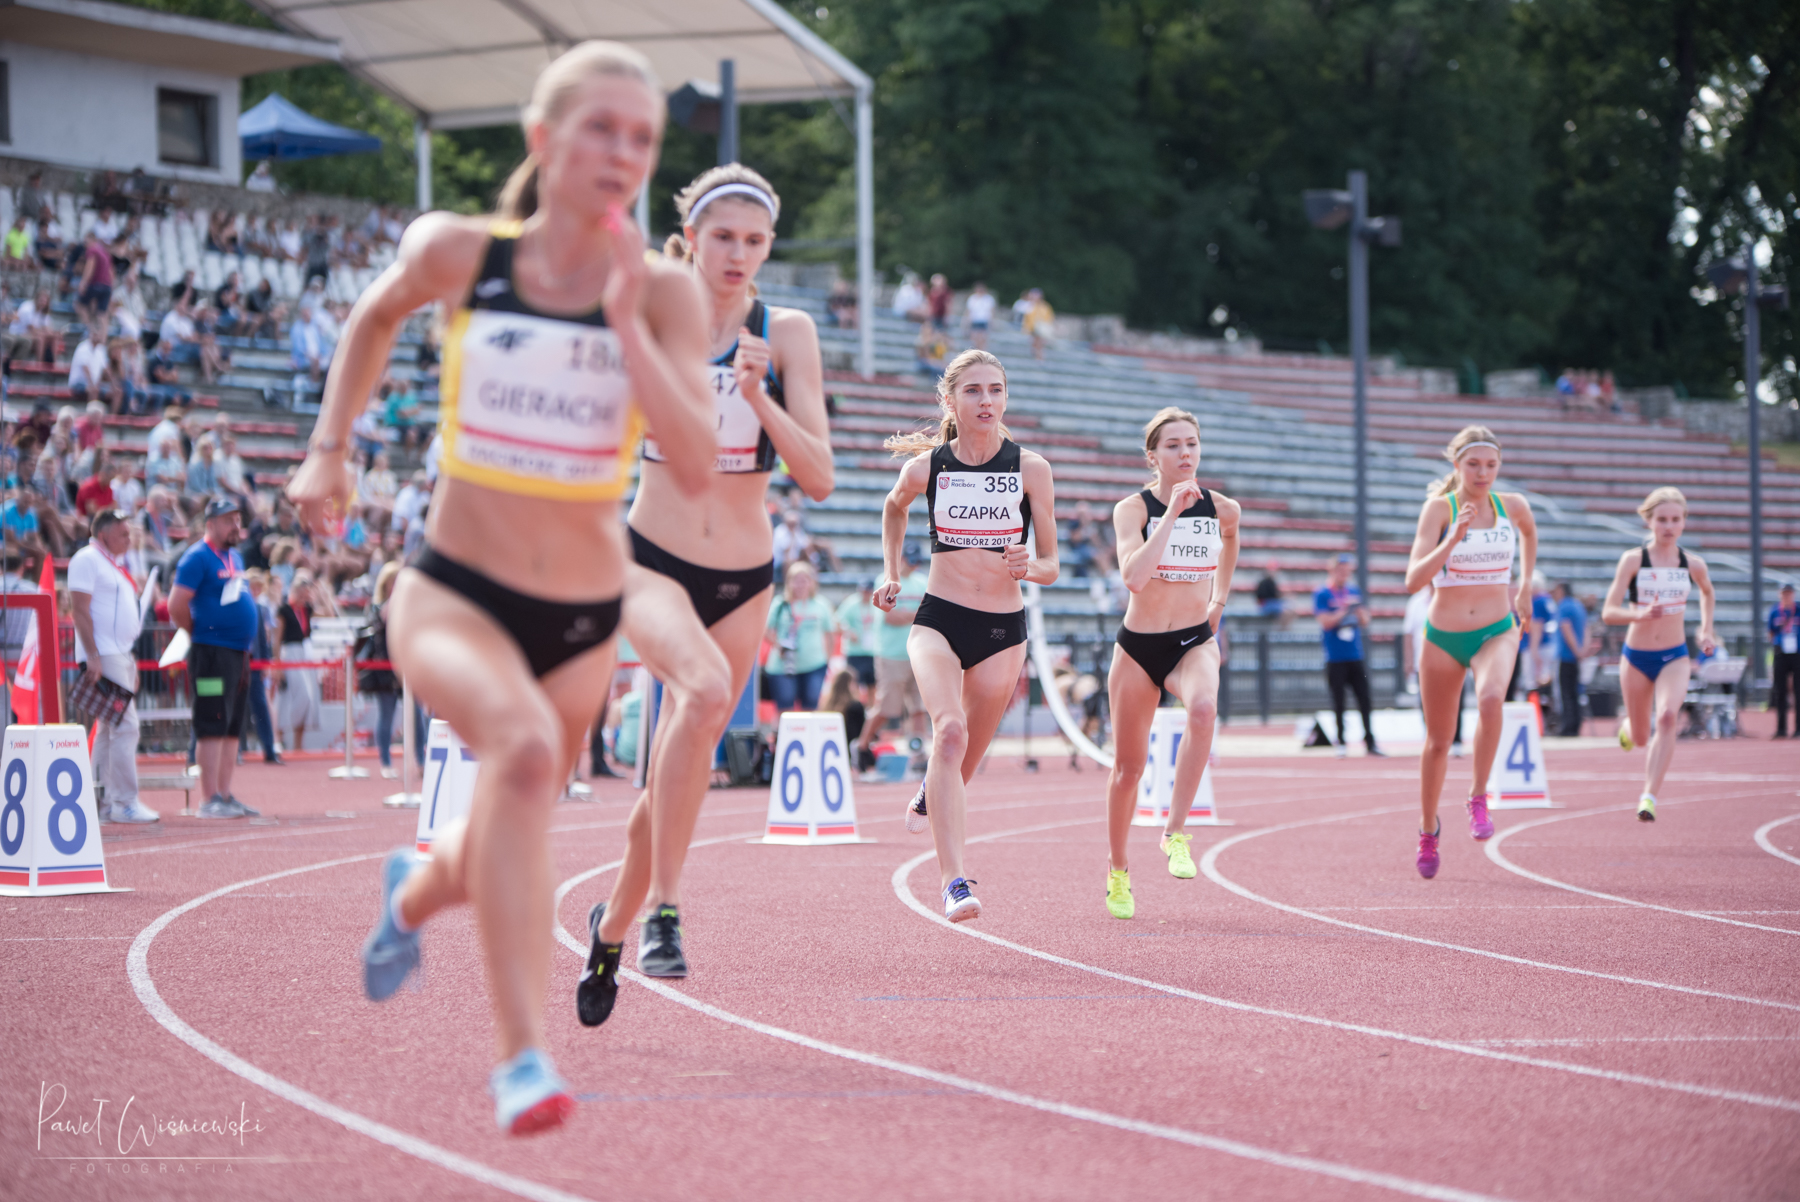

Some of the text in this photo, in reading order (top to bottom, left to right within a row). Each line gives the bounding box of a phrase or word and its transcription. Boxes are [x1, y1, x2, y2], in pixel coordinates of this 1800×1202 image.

[984, 475, 1019, 493] 358
[948, 505, 1010, 520] CZAPKA
[944, 535, 1012, 546] RACIBÓRZ 2019
[1483, 531, 1509, 544] 175
[1170, 544, 1209, 558] TYPER
[1452, 551, 1510, 564] DZIAŁOSZEWSKA
[1160, 571, 1197, 581] RACIBÓRZ
[1667, 571, 1688, 582] 336
[13, 740, 30, 749] polanik
[56, 739, 81, 749] polanik
[1506, 725, 1536, 783] 4
[781, 740, 805, 813] 6
[820, 740, 844, 813] 6
[429, 747, 449, 830] 7
[0, 757, 28, 857] 8
[46, 757, 88, 856] 8
